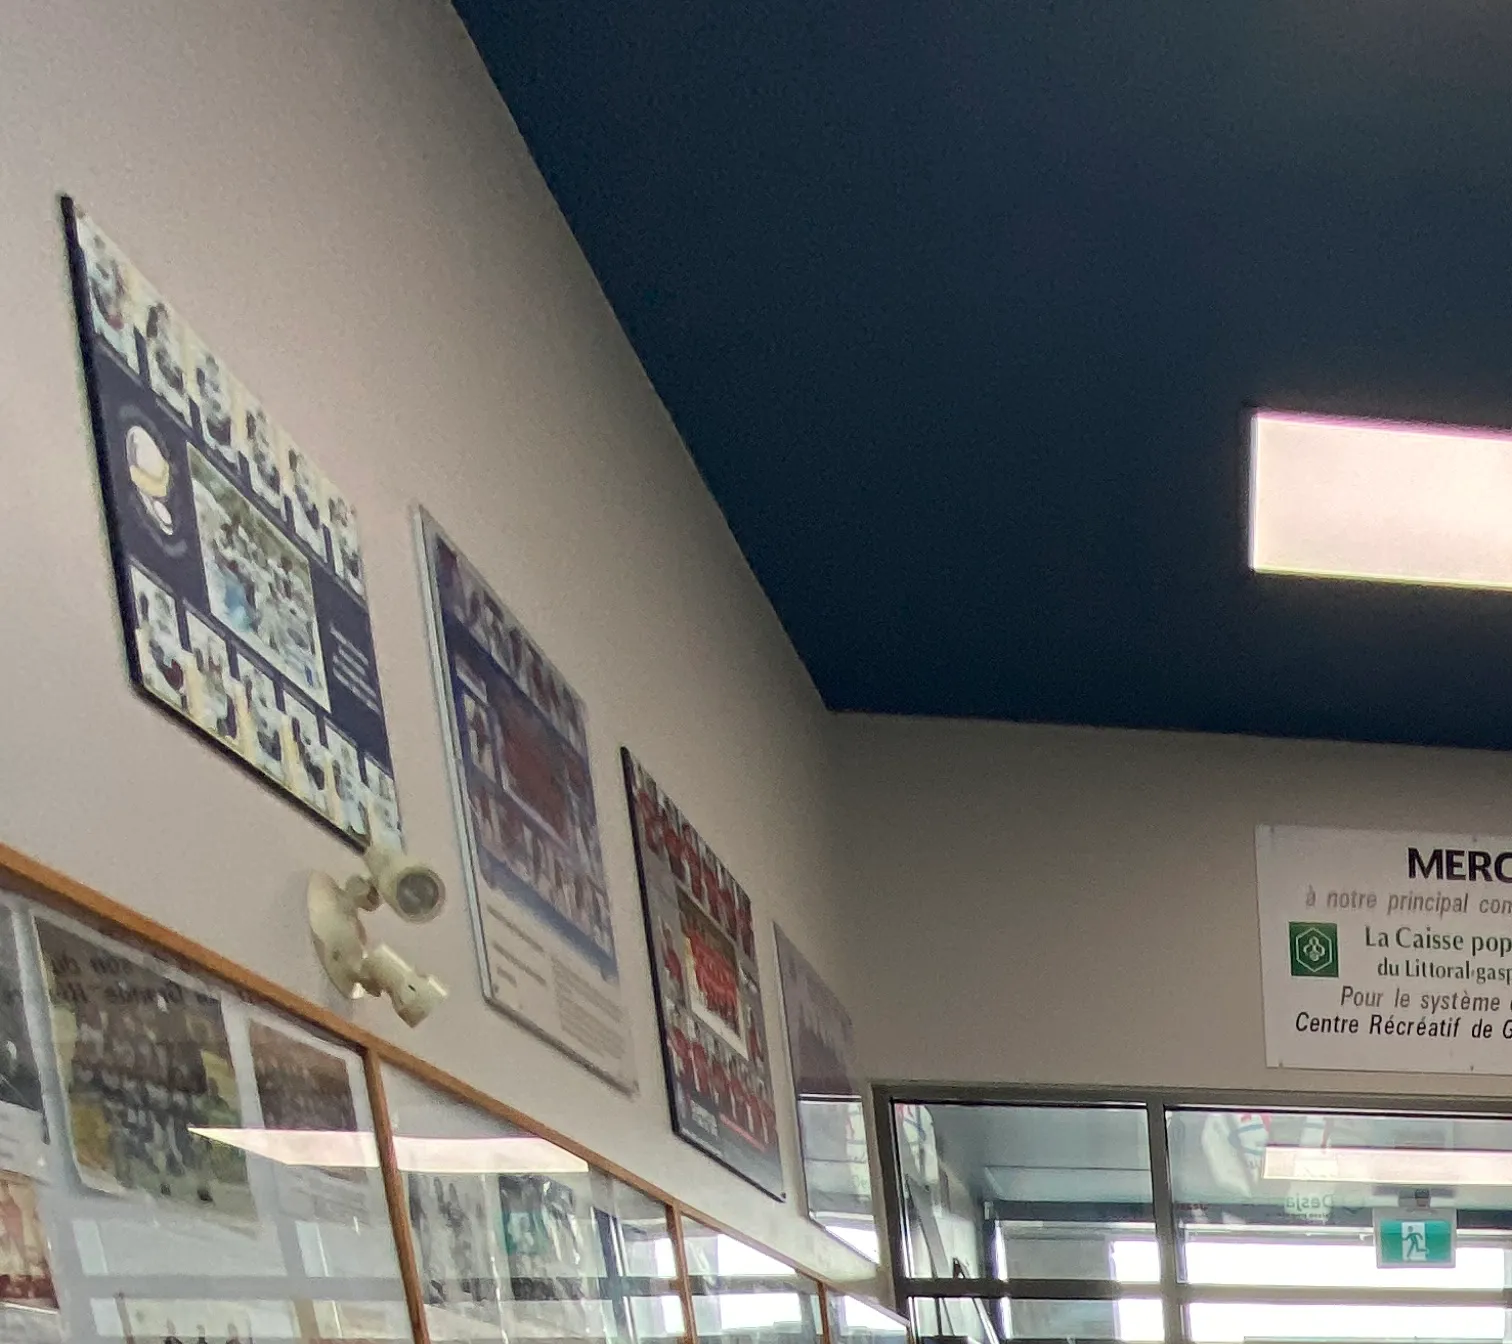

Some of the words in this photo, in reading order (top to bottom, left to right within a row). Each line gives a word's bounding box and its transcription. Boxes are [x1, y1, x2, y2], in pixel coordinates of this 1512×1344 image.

[1305, 886, 1317, 908] à
[1326, 888, 1378, 910] notre
[1387, 892, 1469, 919] principal
[1365, 926, 1390, 948] La
[1395, 926, 1464, 951] Caisse
[1377, 957, 1400, 977] du
[1341, 986, 1383, 1009] Pour
[1394, 989, 1411, 1009] le
[1420, 990, 1501, 1014] système
[1295, 1012, 1360, 1033] Centre
[1369, 1013, 1461, 1037] Récréatif
[1471, 1018, 1493, 1038] de
